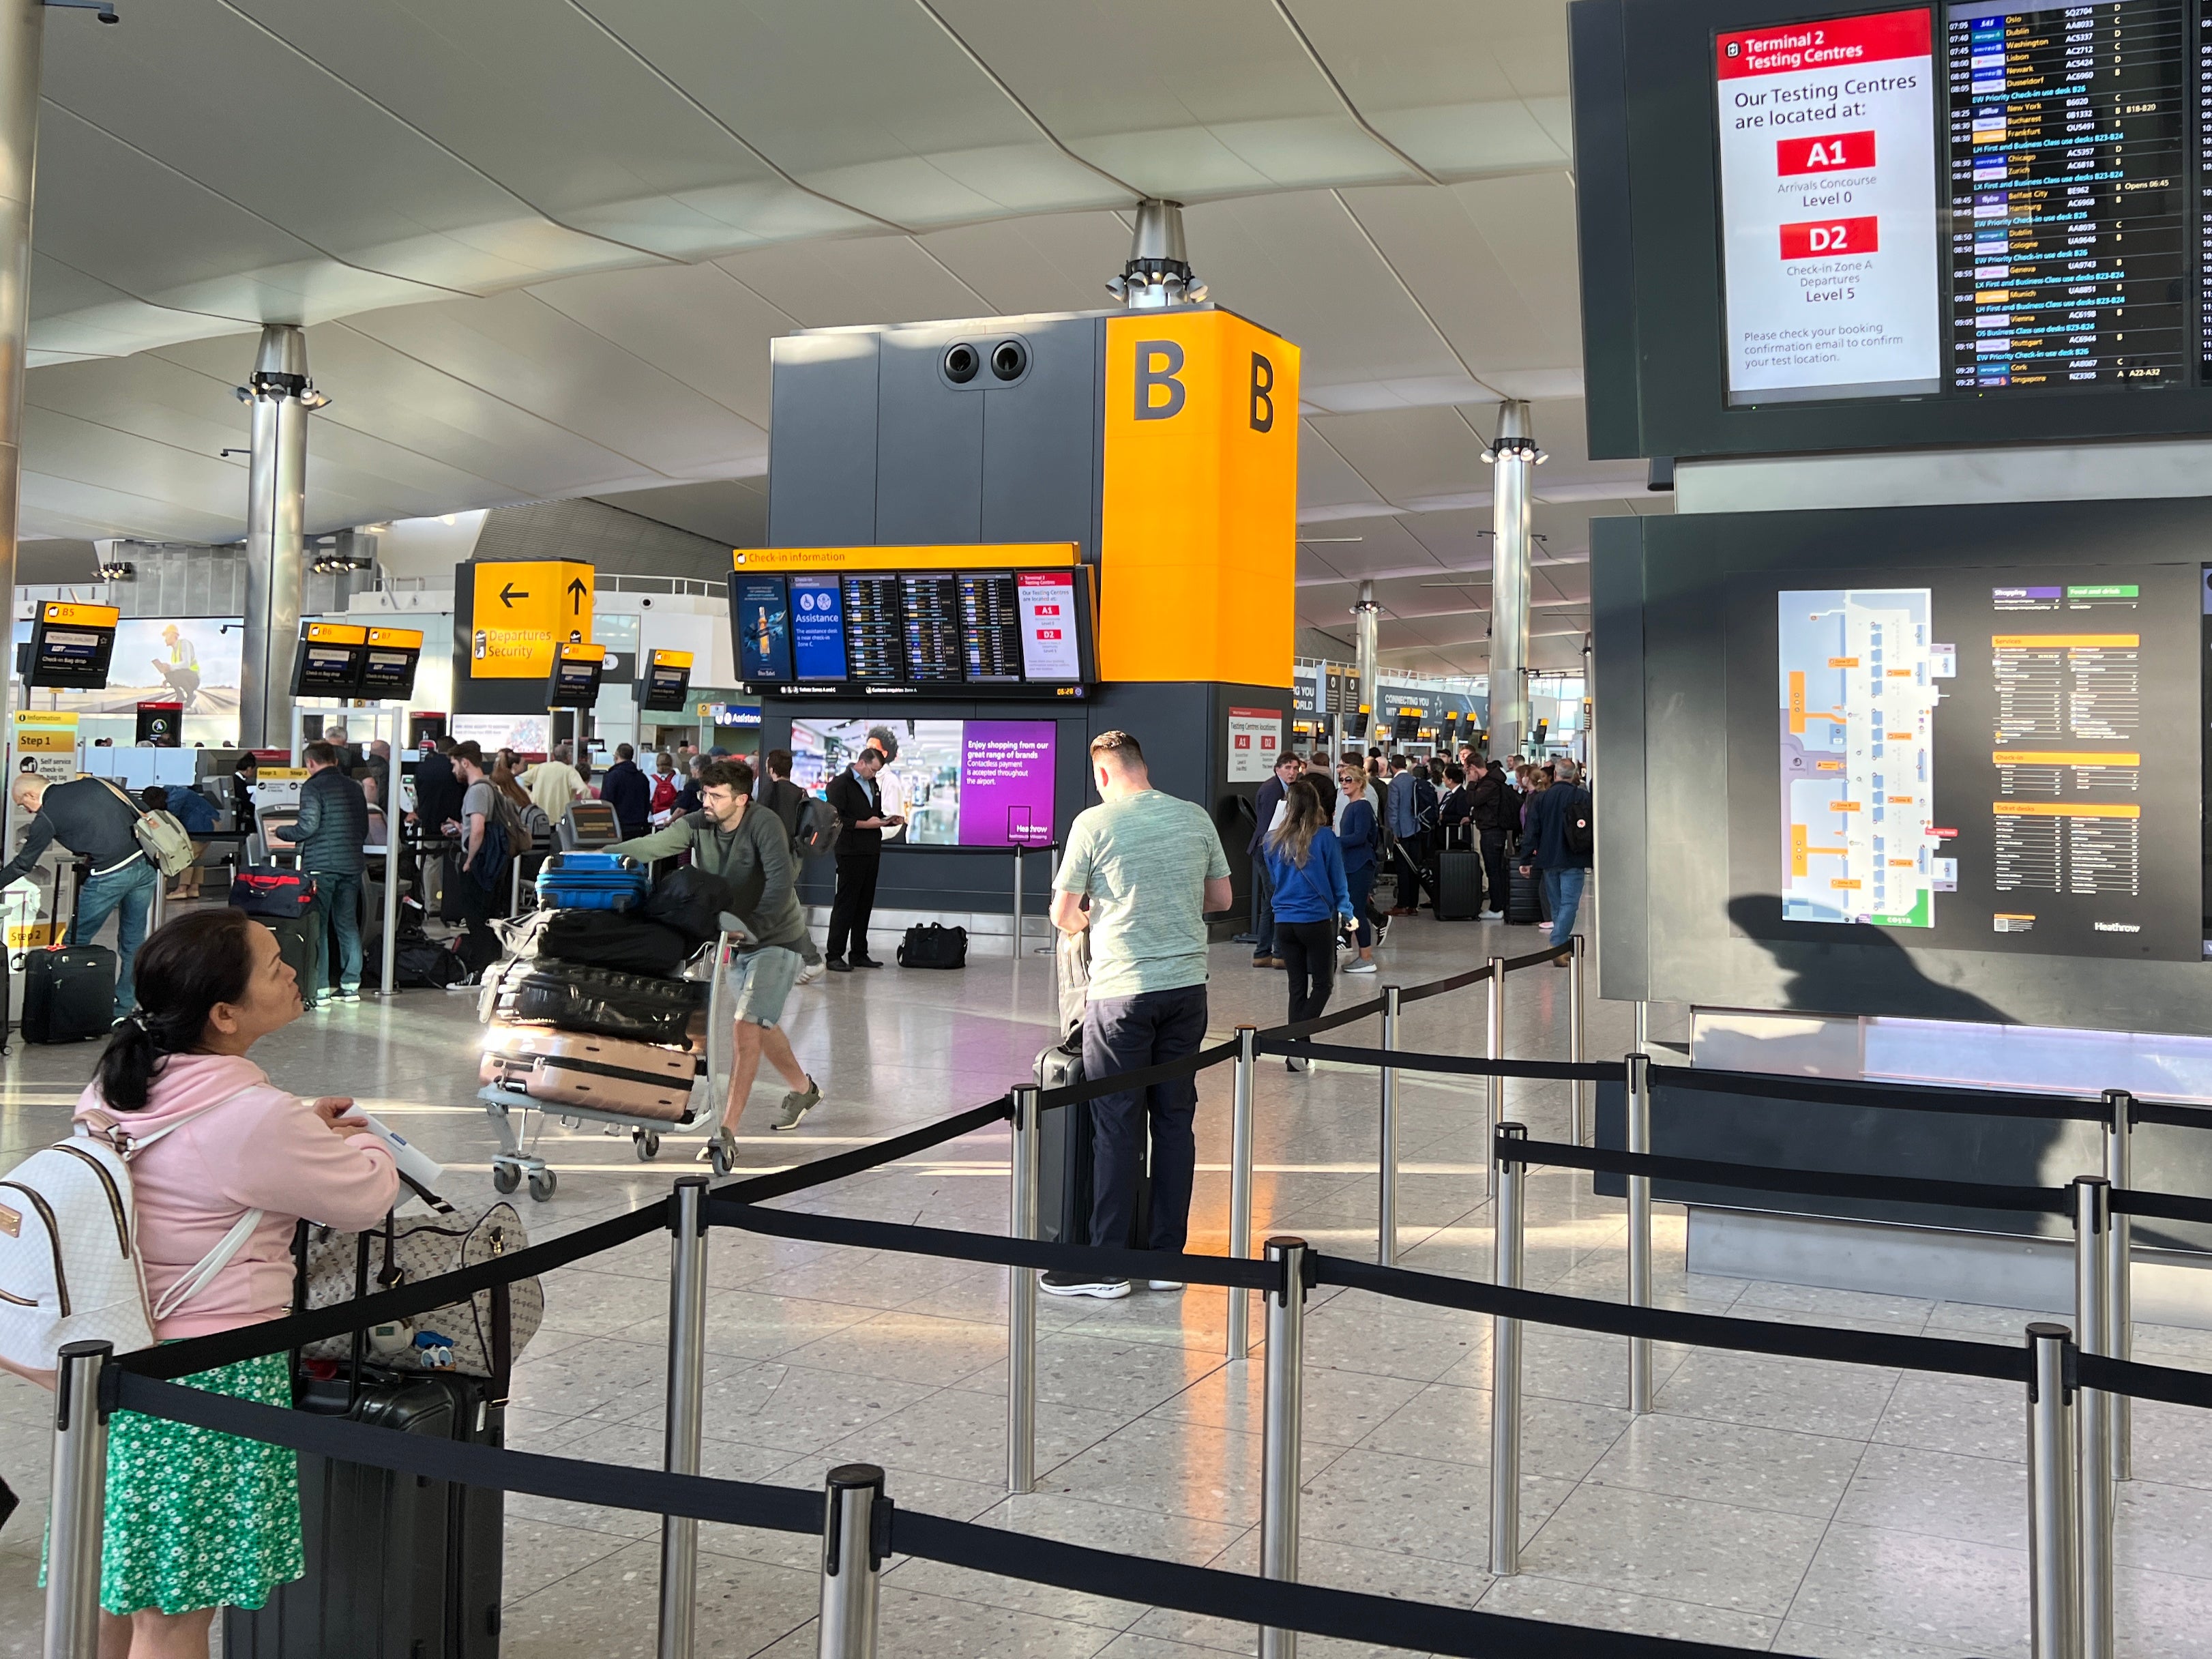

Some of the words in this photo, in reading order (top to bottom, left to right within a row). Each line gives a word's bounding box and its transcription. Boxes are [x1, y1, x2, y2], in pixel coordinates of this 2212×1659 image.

[1949, 22, 1968, 30] 07:05
[1949, 34, 1969, 42] 07:40
[2006, 28, 2030, 36] Dublin
[1745, 32, 1811, 54] Terminal
[1814, 31, 1825, 45] 2
[1950, 47, 1969, 55] 07:45
[2006, 39, 2049, 49] Washington
[1746, 52, 1801, 70] Testing
[1804, 45, 1863, 63] Centres
[2007, 54, 2029, 62] Lisbon
[2065, 46, 2093, 55] AC2712
[2007, 65, 2034, 74] Newark
[2007, 76, 2044, 87] Dusseldorf
[1735, 92, 1767, 108] Our
[1771, 83, 1838, 103] Testing
[1844, 75, 1917, 94] Centres
[1735, 115, 1763, 130] are
[1770, 104, 1836, 126] located
[1842, 102, 1866, 117] at:
[2007, 116, 2041, 125] Bucharest
[2008, 128, 2041, 137] Frankfurt
[1807, 141, 1846, 167] A1
[1778, 181, 1817, 194] Arrivals
[1820, 176, 1876, 189] Concourse
[1803, 192, 1839, 207] Level
[1844, 191, 1852, 203] 0
[1810, 226, 1847, 252] D2
[1786, 263, 1832, 276] Check-in
[1835, 262, 1863, 273] Zone
[1865, 261, 1873, 269] A
[1800, 275, 1860, 288] Departures
[1806, 289, 1842, 302] Level
[1847, 288, 1855, 299] 5
[1744, 331, 1777, 342] Please
[1780, 329, 1808, 339] check
[1811, 328, 1836, 339] your
[1839, 323, 1883, 336] booking
[1744, 342, 1812, 355] confirmation
[1815, 338, 1844, 349] email
[1846, 339, 1859, 349] to
[1861, 336, 1903, 347] confirm
[1745, 358, 1769, 370] your
[1771, 355, 1791, 366] test
[1794, 353, 1840, 365] location.
[2129, 368, 2160, 377] A22-A32
[1134, 340, 1185, 420] B
[1250, 351, 1273, 433] B
[749, 552, 788, 562] Check-in
[790, 551, 845, 562] information
[63, 608, 74, 617] B5
[1042, 606, 1052, 615] A1
[795, 614, 839, 623] Assistance
[489, 630, 551, 643] Departures
[488, 646, 533, 660] Security
[1301, 686, 1314, 697] YOU
[1385, 694, 1418, 706] CONNECTING
[1419, 697, 1430, 707] YOU
[732, 713, 761, 724] Assistanc
[1231, 722, 1244, 731] Testing
[21, 736, 42, 747] Step
[45, 737, 50, 745] 1
[968, 741, 986, 750] Enjoy
[988, 741, 1018, 750] shopping
[1019, 741, 1035, 750] from
[1239, 737, 1246, 746] A1
[1265, 738, 1271, 747] D2
[997, 769, 1028, 778] throughout
[1887, 916, 1913, 924] COSTA
[2095, 922, 2140, 933] Heathrow
[11, 932, 33, 941] Step
[35, 930, 41, 939] 2
